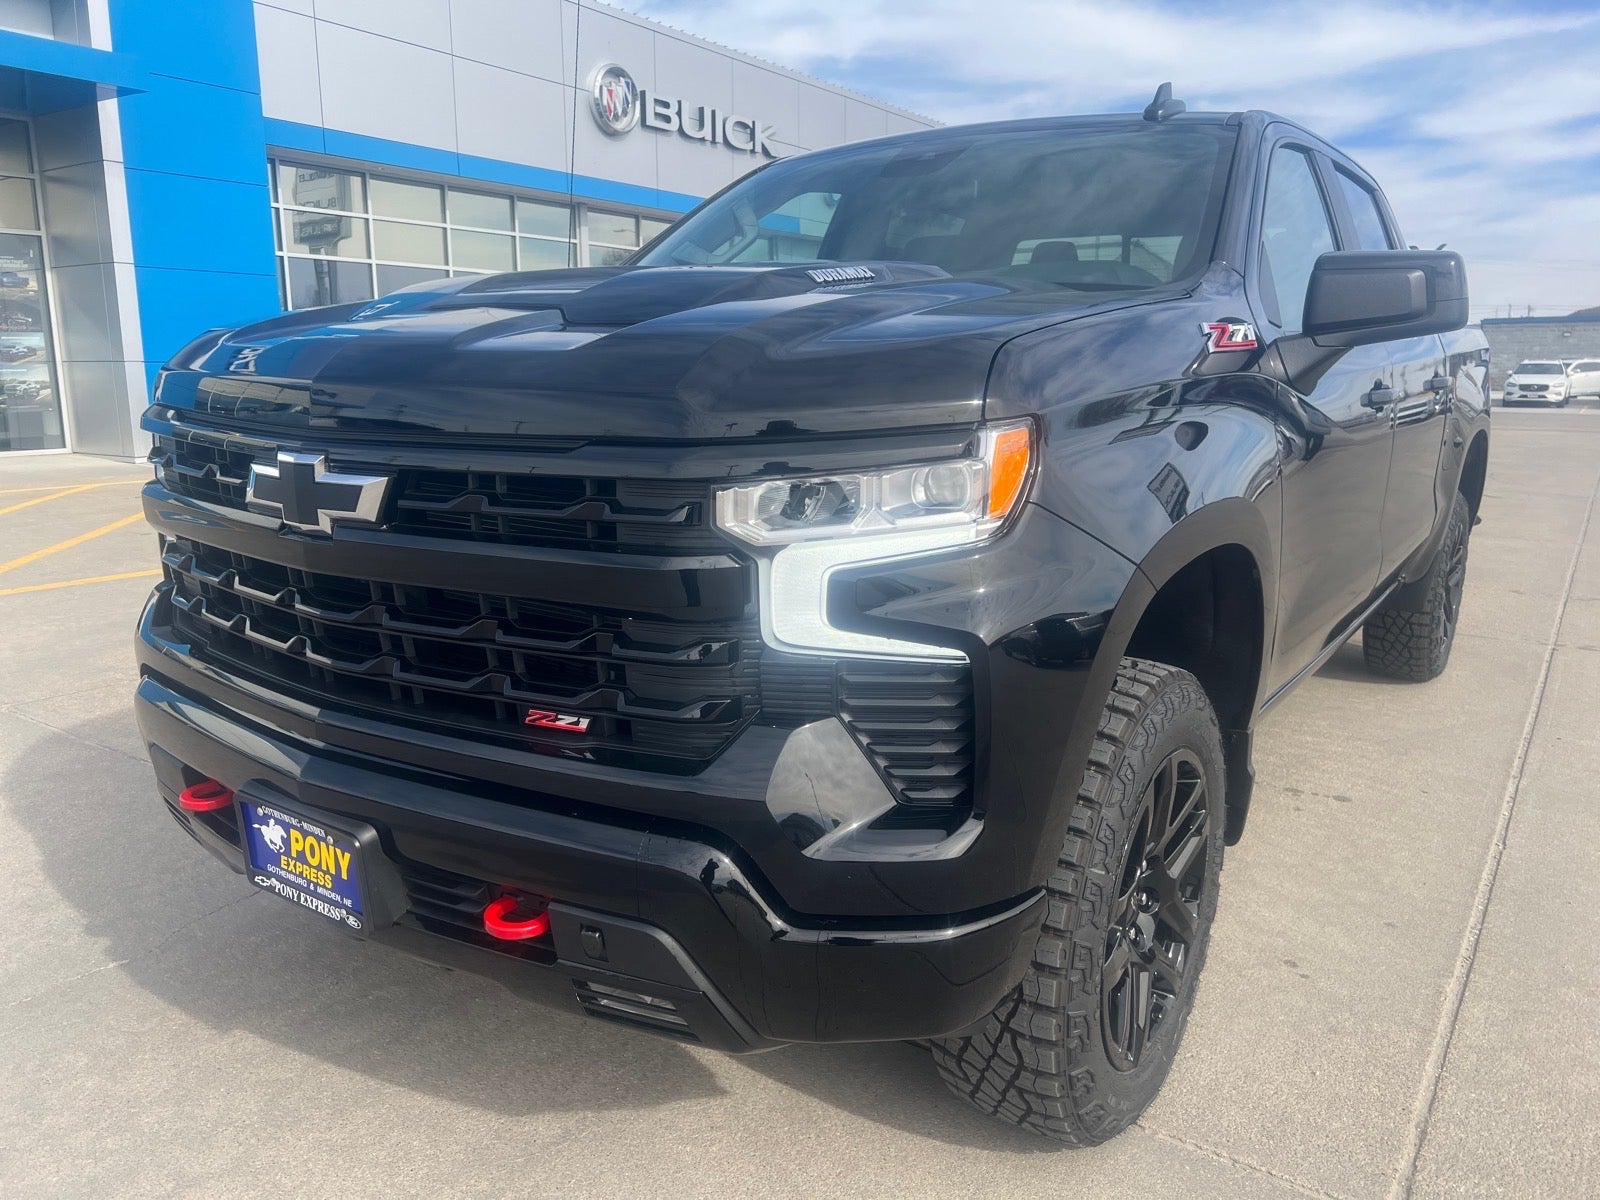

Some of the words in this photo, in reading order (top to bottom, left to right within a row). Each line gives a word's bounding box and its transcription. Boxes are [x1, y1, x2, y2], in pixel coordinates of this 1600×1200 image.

[639, 89, 778, 158] BUICK
[804, 265, 876, 283] DURAMAX
[1199, 322, 1258, 353] Z71
[525, 709, 591, 733] Z71
[280, 855, 333, 889] EXPRESS
[290, 828, 352, 881] PONY
[267, 863, 308, 888] GOTHENBURG
[309, 882, 315, 891] &
[316, 885, 343, 905] MINDEN,
[343, 896, 353, 908] NE
[274, 880, 299, 902] PONY
[299, 892, 341, 921] EXPRESS
